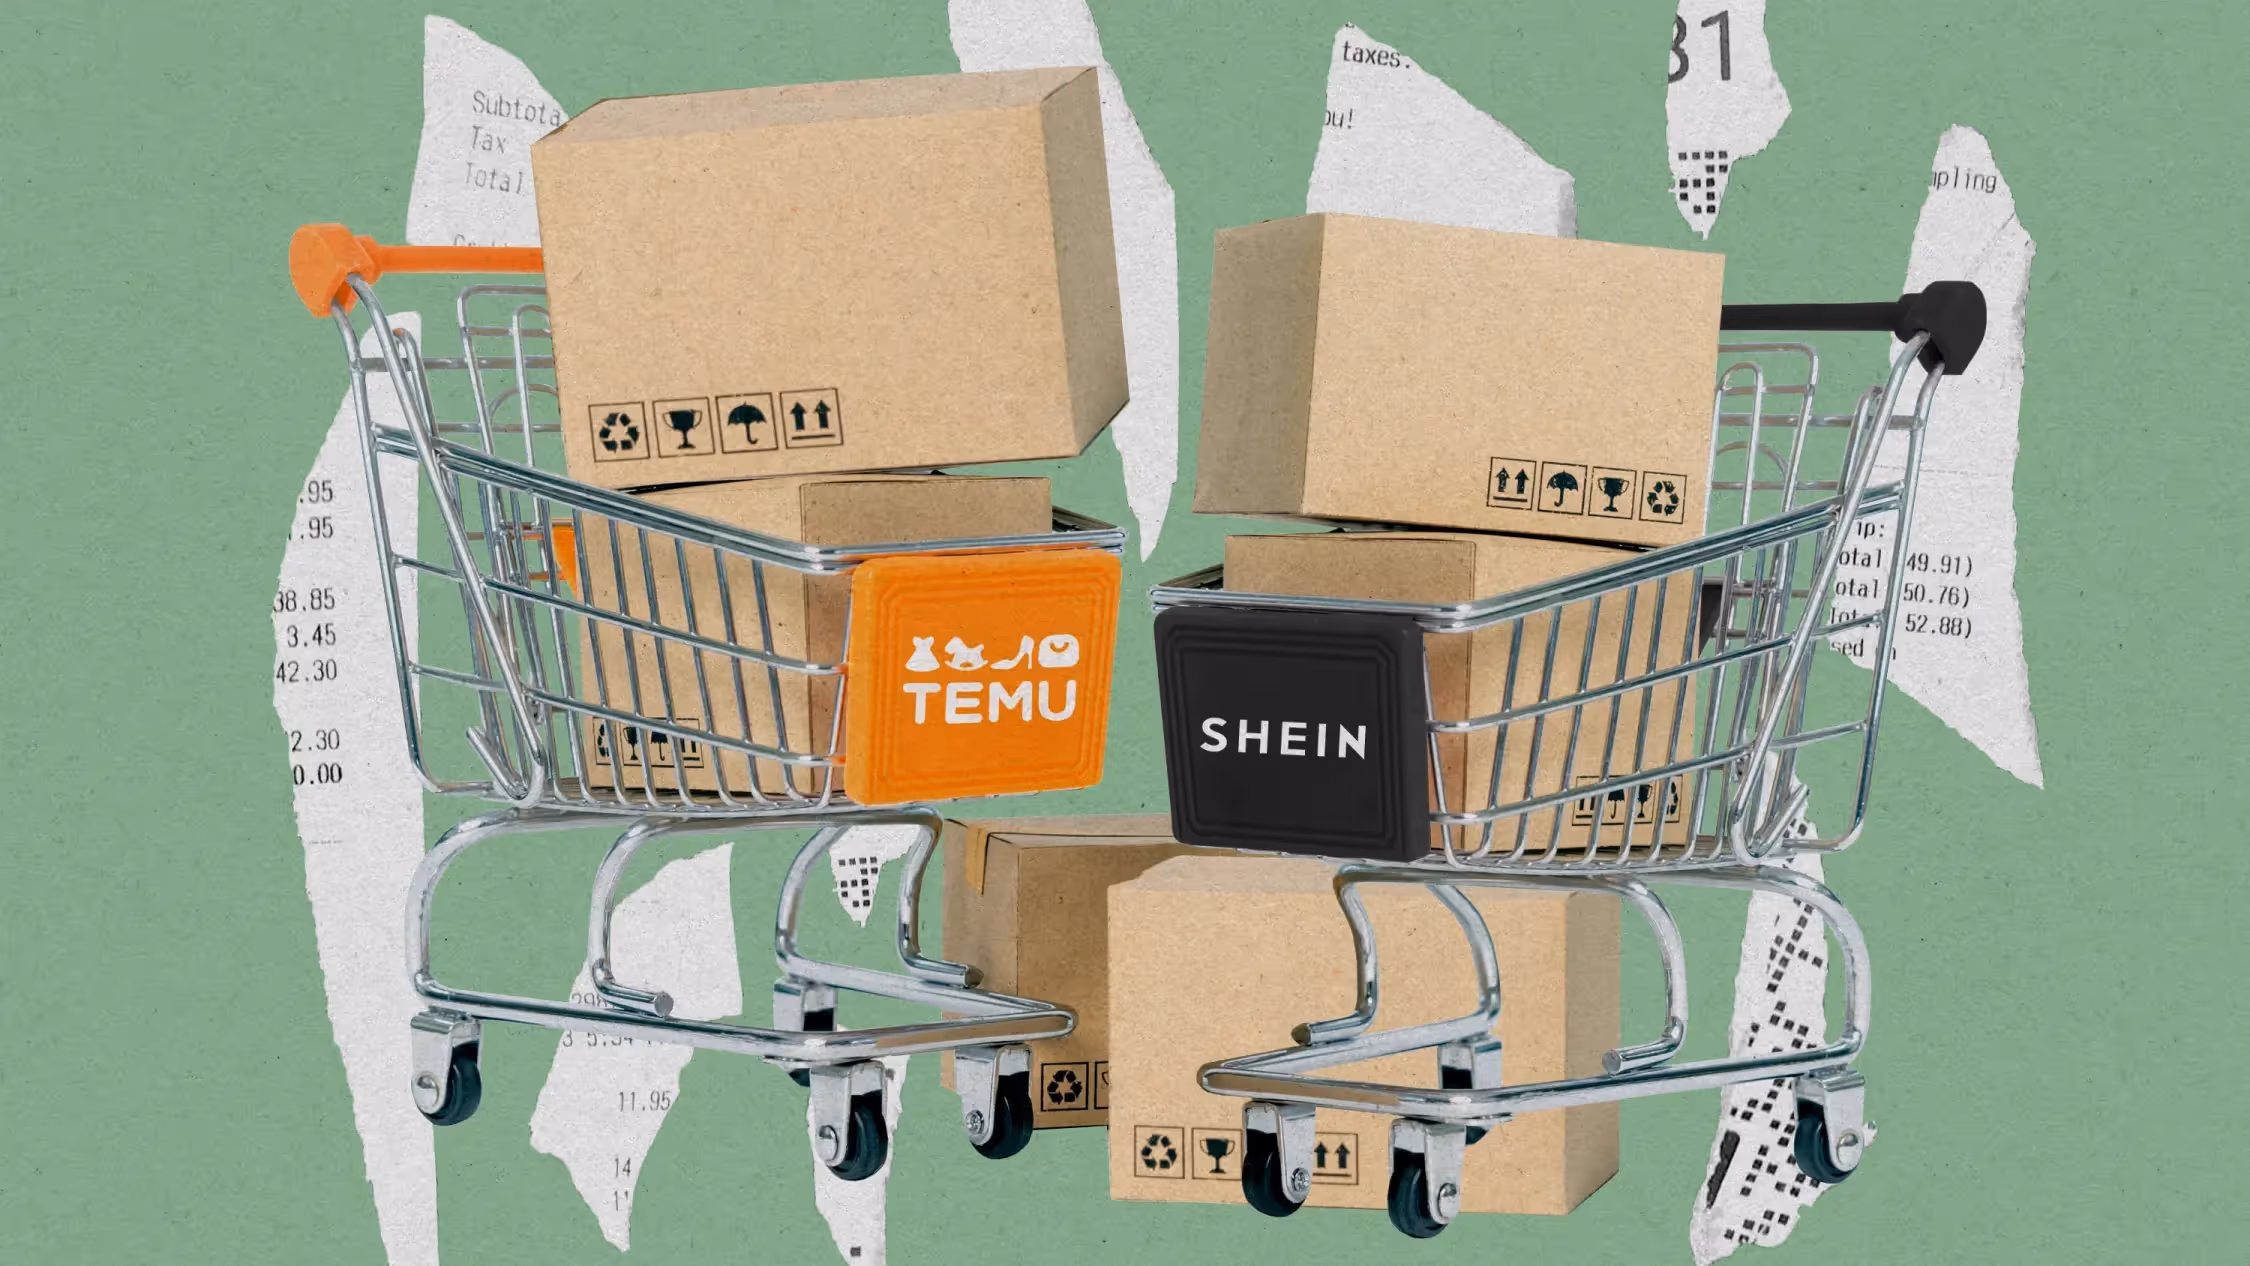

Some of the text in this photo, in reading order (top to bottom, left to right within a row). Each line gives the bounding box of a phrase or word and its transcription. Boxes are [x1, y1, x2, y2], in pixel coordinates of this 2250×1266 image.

[1343, 41, 1410, 70] taxes.
[472, 124, 507, 154] Tax
[465, 161, 523, 195] Total
[300, 480, 333, 503] .95
[288, 516, 334, 541] .95
[287, 623, 336, 648] 3.45
[1905, 613, 1971, 639] 52.88)
[276, 658, 337, 683] 42.30
[903, 680, 1076, 725] TEMU
[290, 729, 340, 752] 2.30
[1200, 717, 1367, 760] SHEIN
[293, 763, 342, 785] 0.00
[619, 1090, 671, 1112] 11.95
